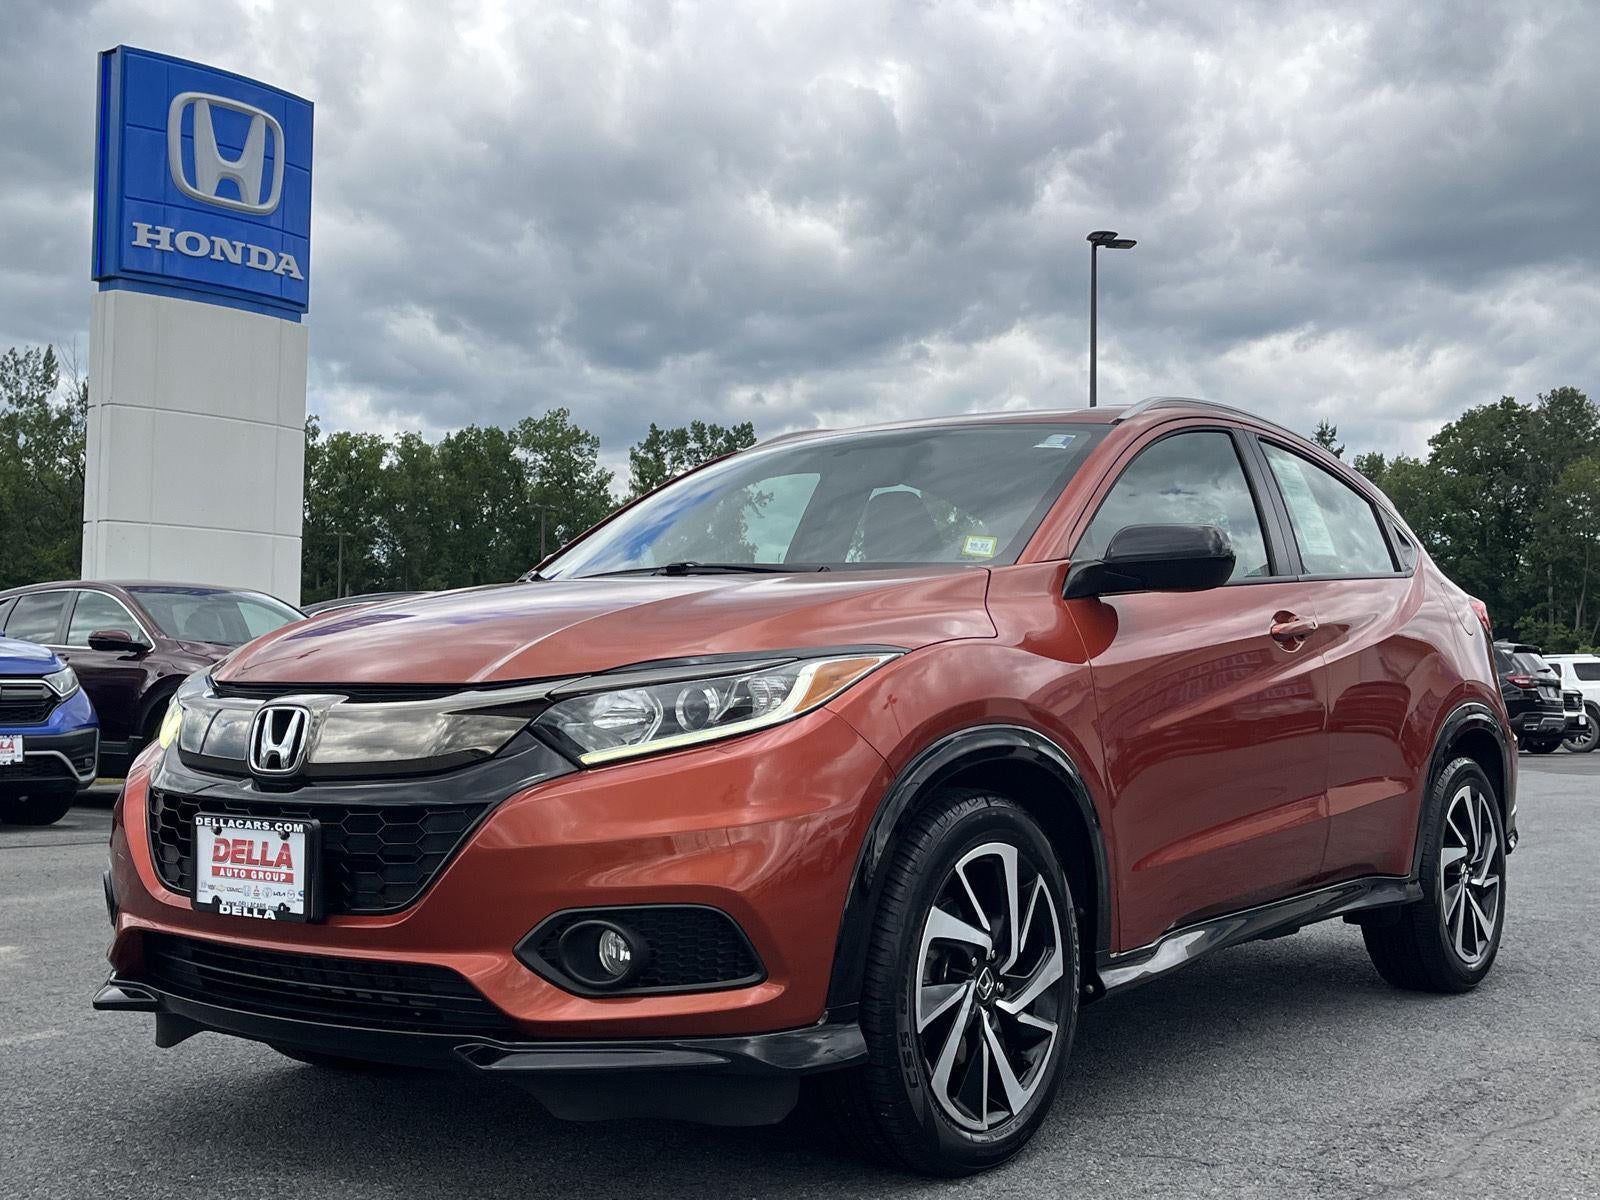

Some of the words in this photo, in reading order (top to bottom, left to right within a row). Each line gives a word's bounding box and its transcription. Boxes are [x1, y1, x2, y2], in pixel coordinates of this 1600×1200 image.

[131, 221, 304, 281] HONDA
[195, 817, 304, 833] DELLACARS.COM
[212, 837, 294, 869] DELLA
[219, 868, 246, 877] AUTO
[251, 871, 286, 882] GROUP
[219, 905, 276, 920] DELLA
